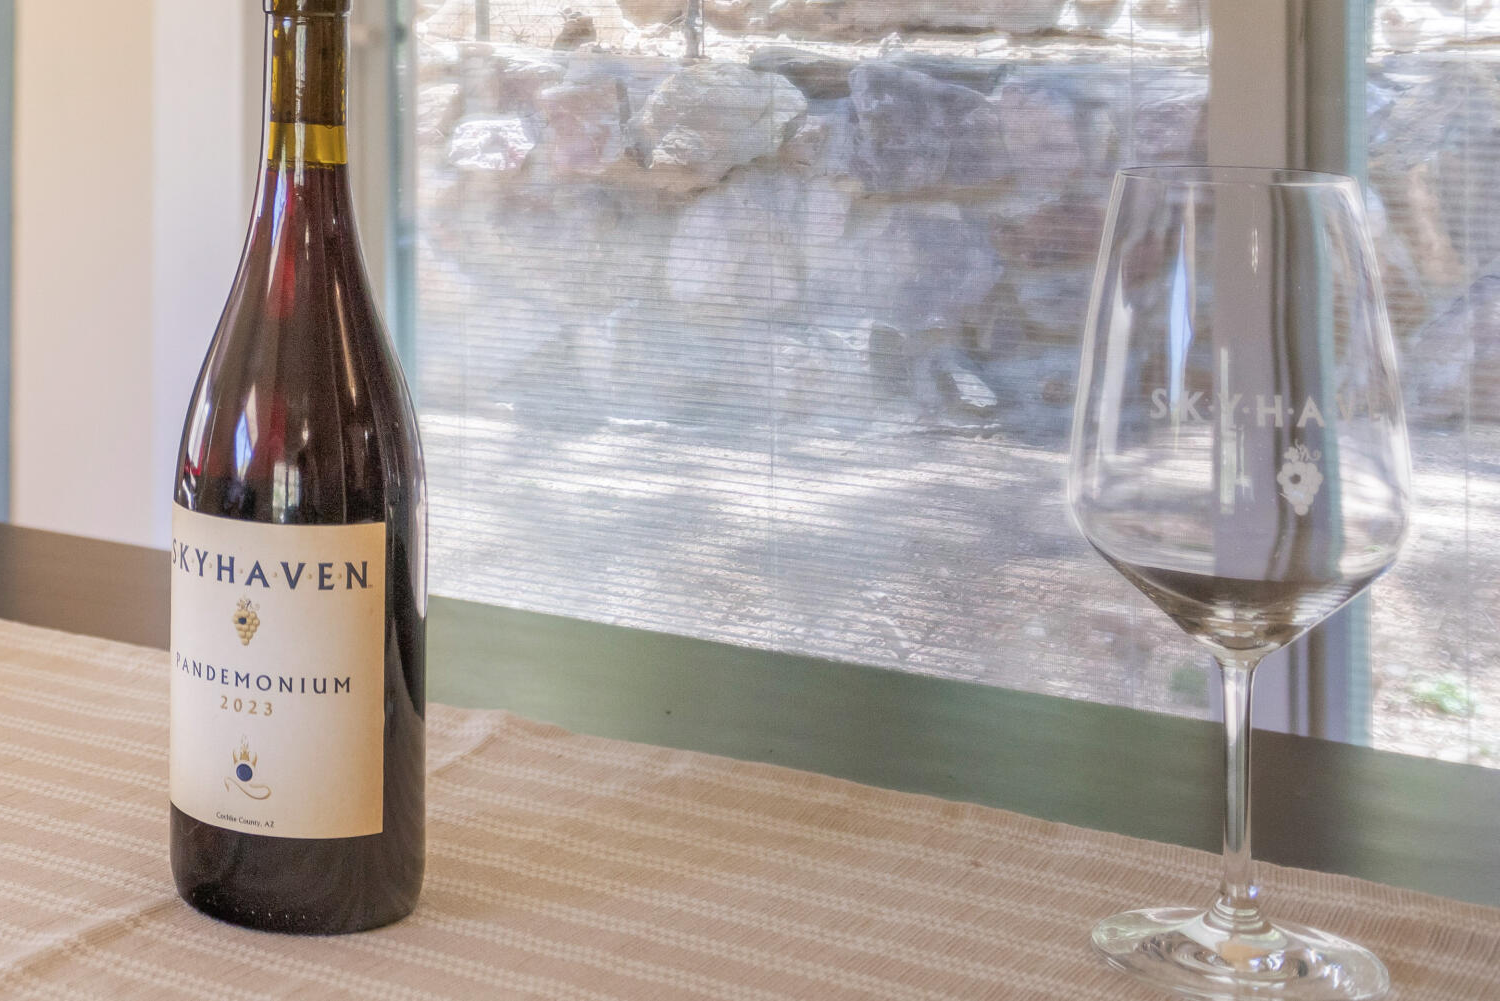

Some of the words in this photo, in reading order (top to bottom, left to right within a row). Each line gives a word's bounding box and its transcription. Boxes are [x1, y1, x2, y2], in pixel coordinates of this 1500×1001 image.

[172, 537, 368, 590] SKYHAVEN
[176, 651, 351, 694] PANDEMONIUM
[220, 696, 273, 717] 2023
[264, 820, 275, 828] AZ
